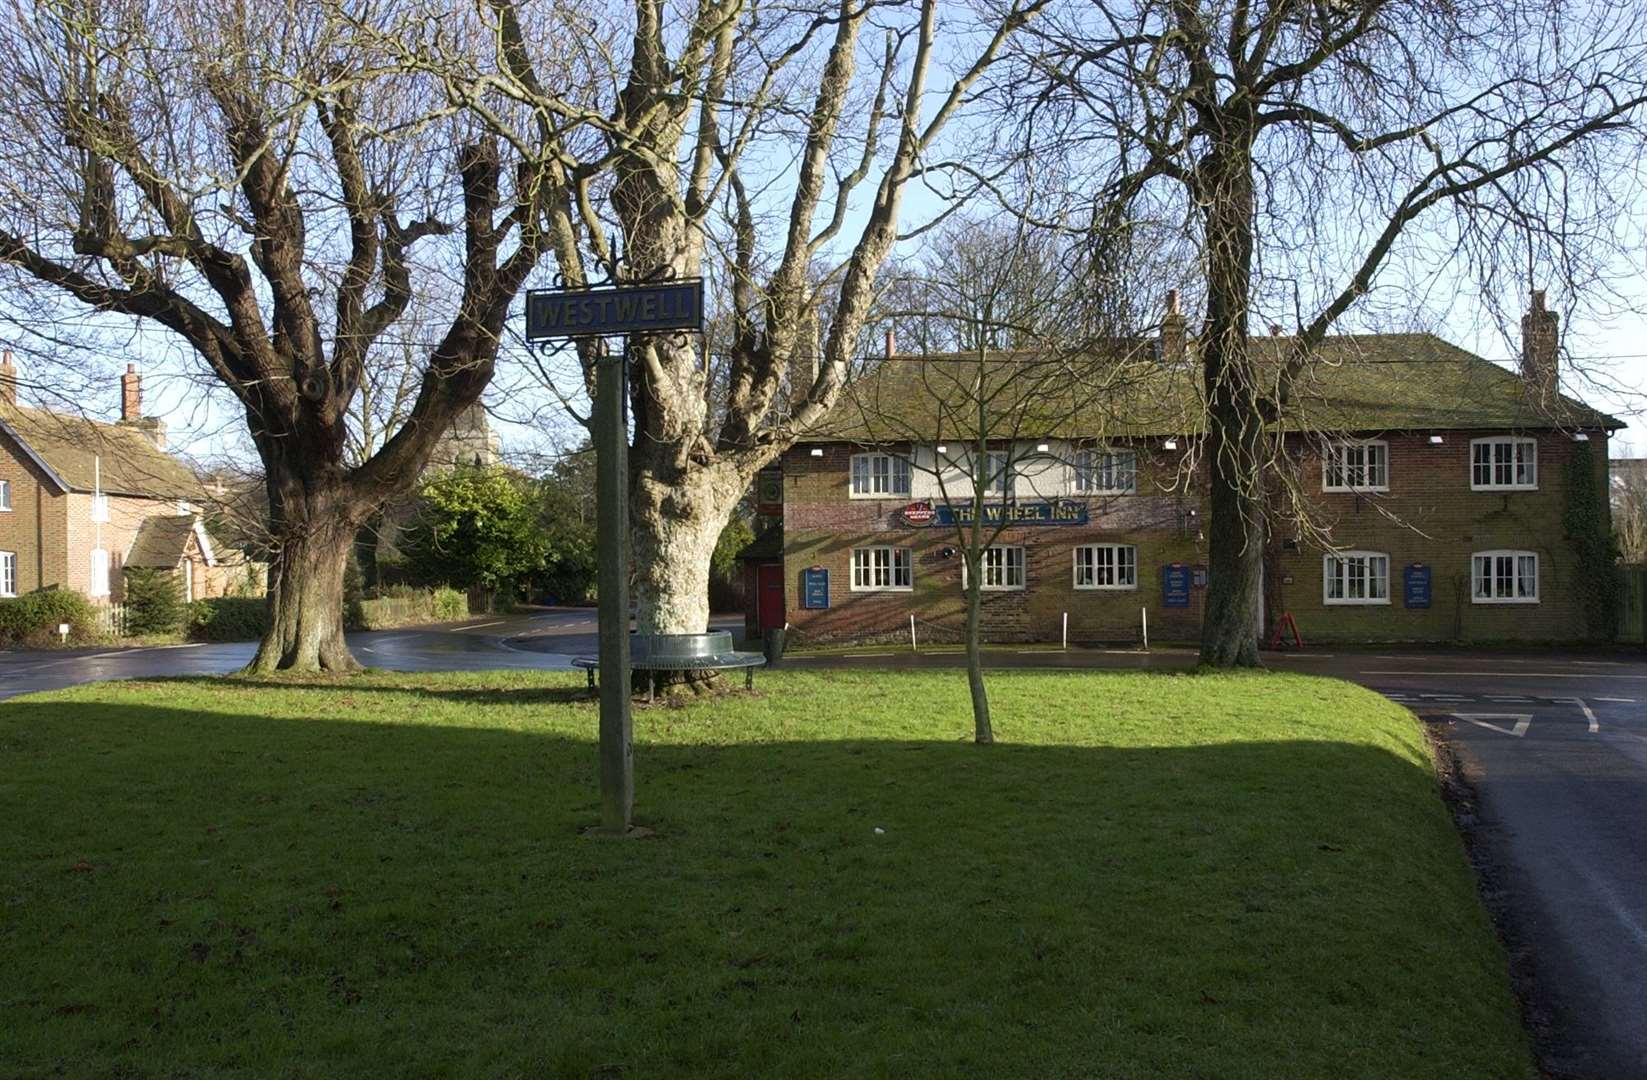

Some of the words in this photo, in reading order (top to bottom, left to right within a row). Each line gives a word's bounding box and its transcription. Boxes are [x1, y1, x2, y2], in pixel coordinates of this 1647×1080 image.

[537, 293, 690, 327] WESTWELL
[986, 507, 1046, 520] WHEEL
[1050, 506, 1080, 520] INN
